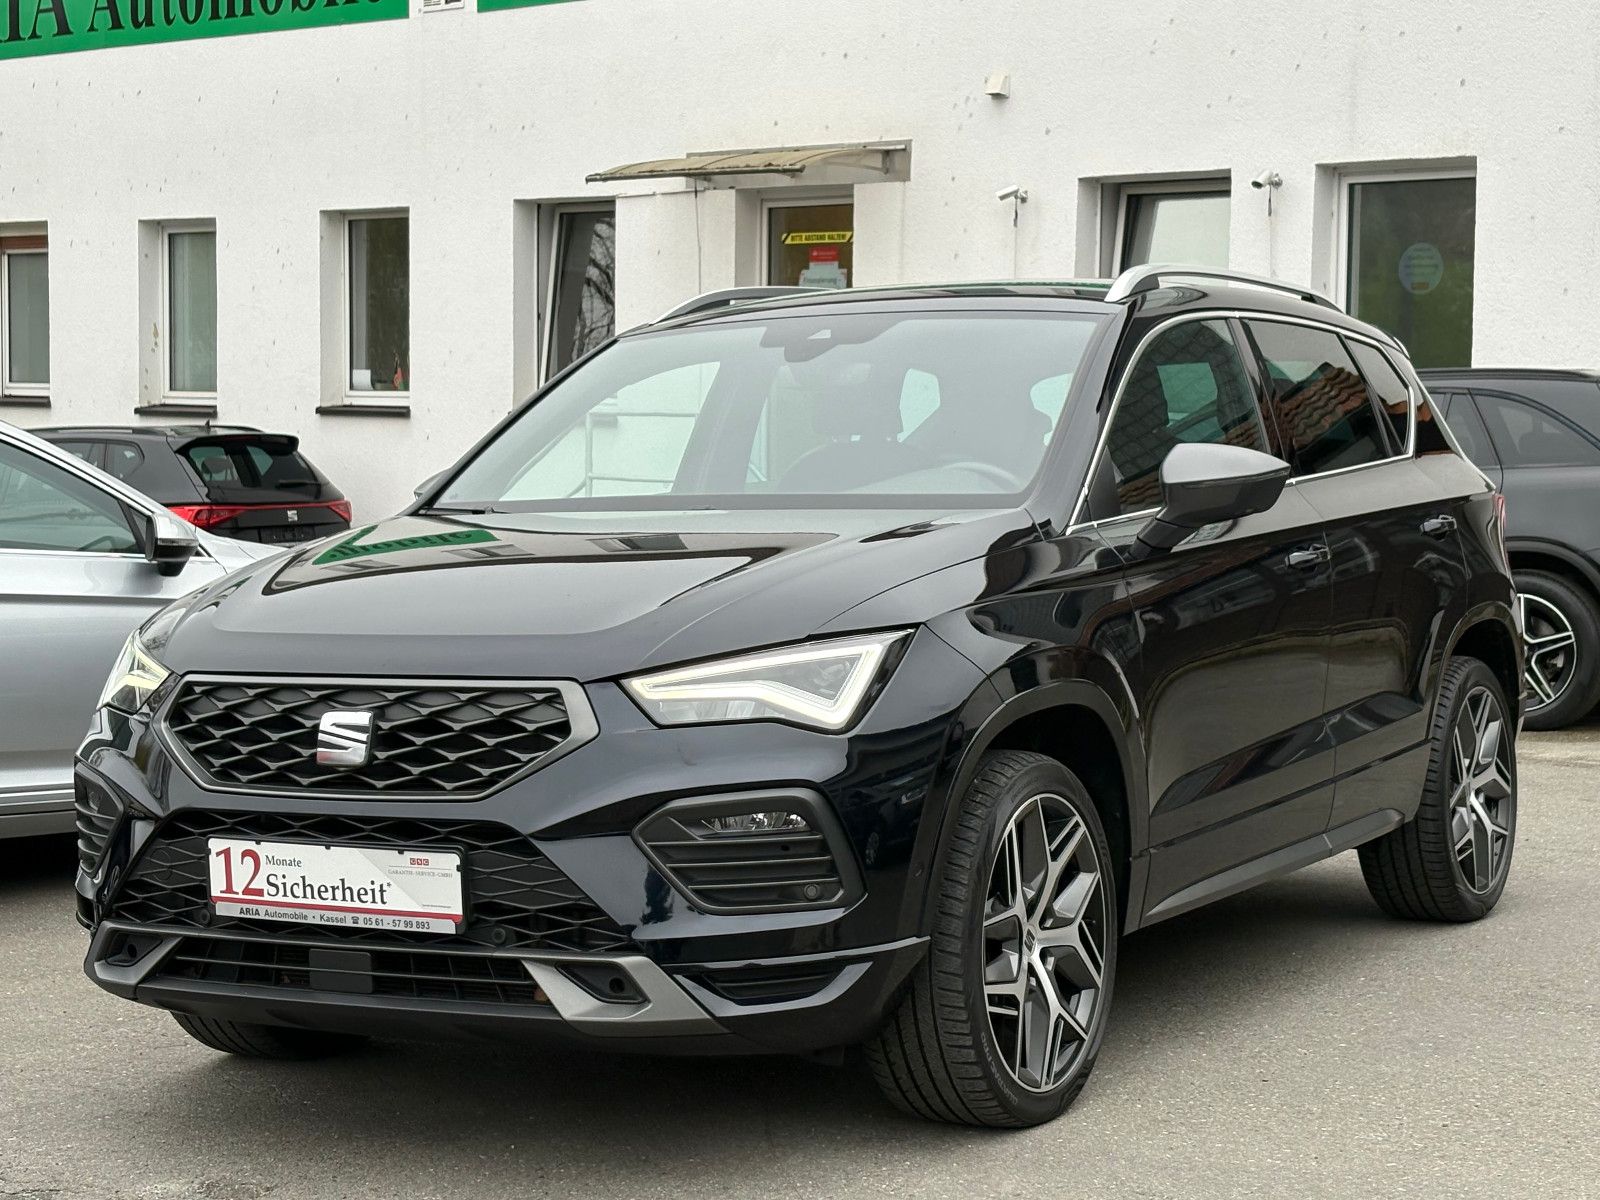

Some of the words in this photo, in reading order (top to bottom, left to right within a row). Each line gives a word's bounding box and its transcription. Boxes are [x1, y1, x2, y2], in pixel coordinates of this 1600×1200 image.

[215, 846, 265, 897] 12
[265, 854, 302, 868] Monate
[239, 907, 261, 916] ARIA
[264, 909, 309, 920] Automobile
[319, 914, 347, 924] Kassel
[415, 921, 431, 930] 893
